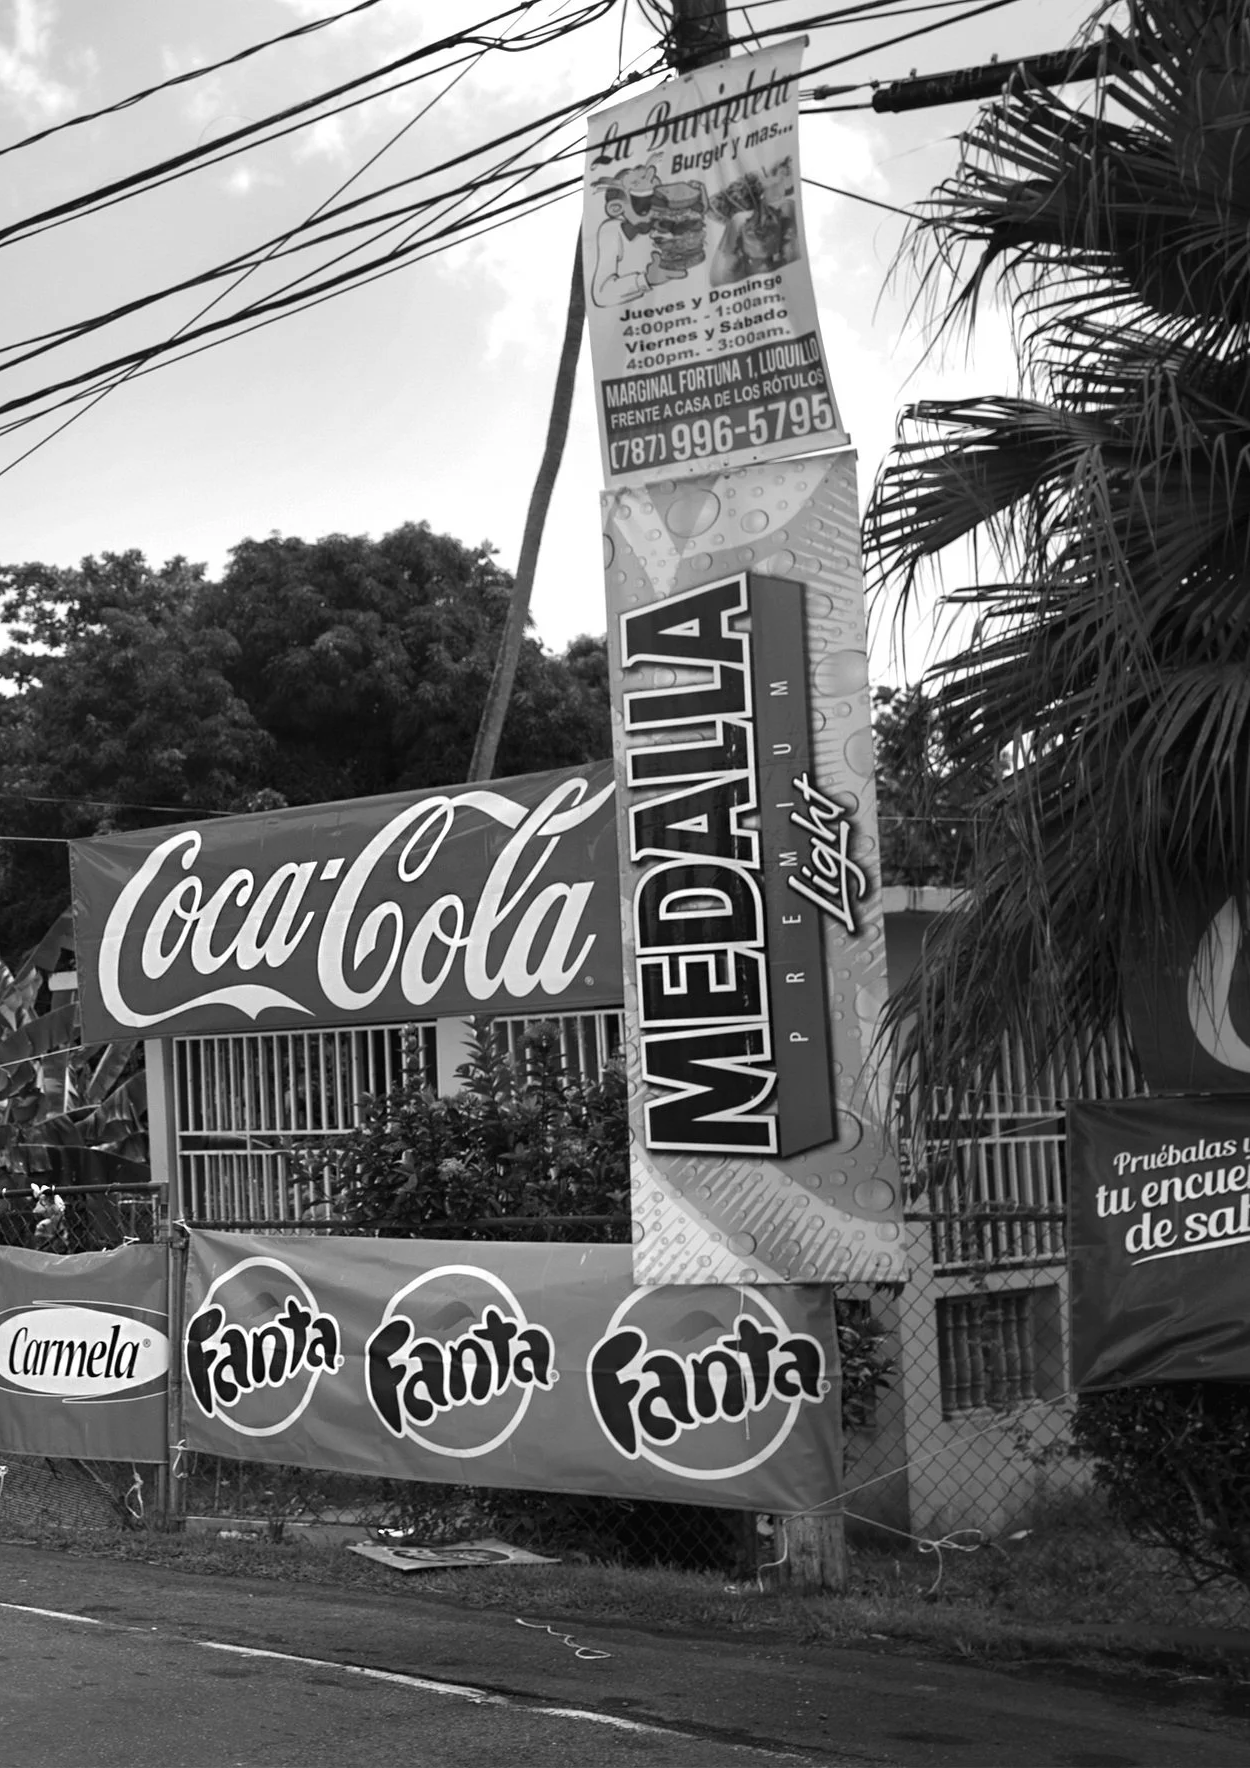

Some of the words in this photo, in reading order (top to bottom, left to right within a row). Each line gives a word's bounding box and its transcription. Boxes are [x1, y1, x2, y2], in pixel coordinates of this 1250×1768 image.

[590, 121, 634, 171] La
[732, 136, 741, 160] y
[620, 300, 686, 322] Jueves
[692, 297, 703, 310] y
[709, 275, 783, 304] Domingo
[622, 315, 698, 338] 4:00pm.
[715, 292, 786, 317] 1:00am.
[625, 331, 699, 354] Viernes
[705, 327, 715, 341] y
[720, 307, 789, 333] Sábado
[626, 347, 701, 370] 4:00pm.
[718, 324, 791, 351] 3:00am.
[606, 376, 677, 408] MARGINAL
[679, 358, 742, 394] FORTUNA
[745, 355, 758, 381] 1,
[759, 336, 820, 376] LUQUILLO
[611, 407, 660, 429] FRENTE
[663, 403, 673, 418] A
[675, 397, 712, 417] CASA
[714, 391, 731, 407] DE
[734, 382, 761, 404] LOS
[765, 366, 825, 396] RÓTULOS
[610, 432, 667, 470] (787)
[671, 391, 834, 461] 996-5795
[619, 571, 778, 1154] MEDALLA
[769, 680, 810, 1043] PREMIUM
[788, 772, 866, 932] Light
[99, 777, 616, 1028] Coca-Cola
[1113, 1138, 1237, 1176] Pruébalas
[1096, 1184, 1136, 1218] tu
[1141, 1164, 1250, 1218] encue
[1125, 1211, 1178, 1253] de
[8, 1325, 138, 1379] Carmela
[185, 1295, 343, 1418] Fanta
[365, 1304, 555, 1438] Fanta
[586, 1314, 826, 1459] Fanta
